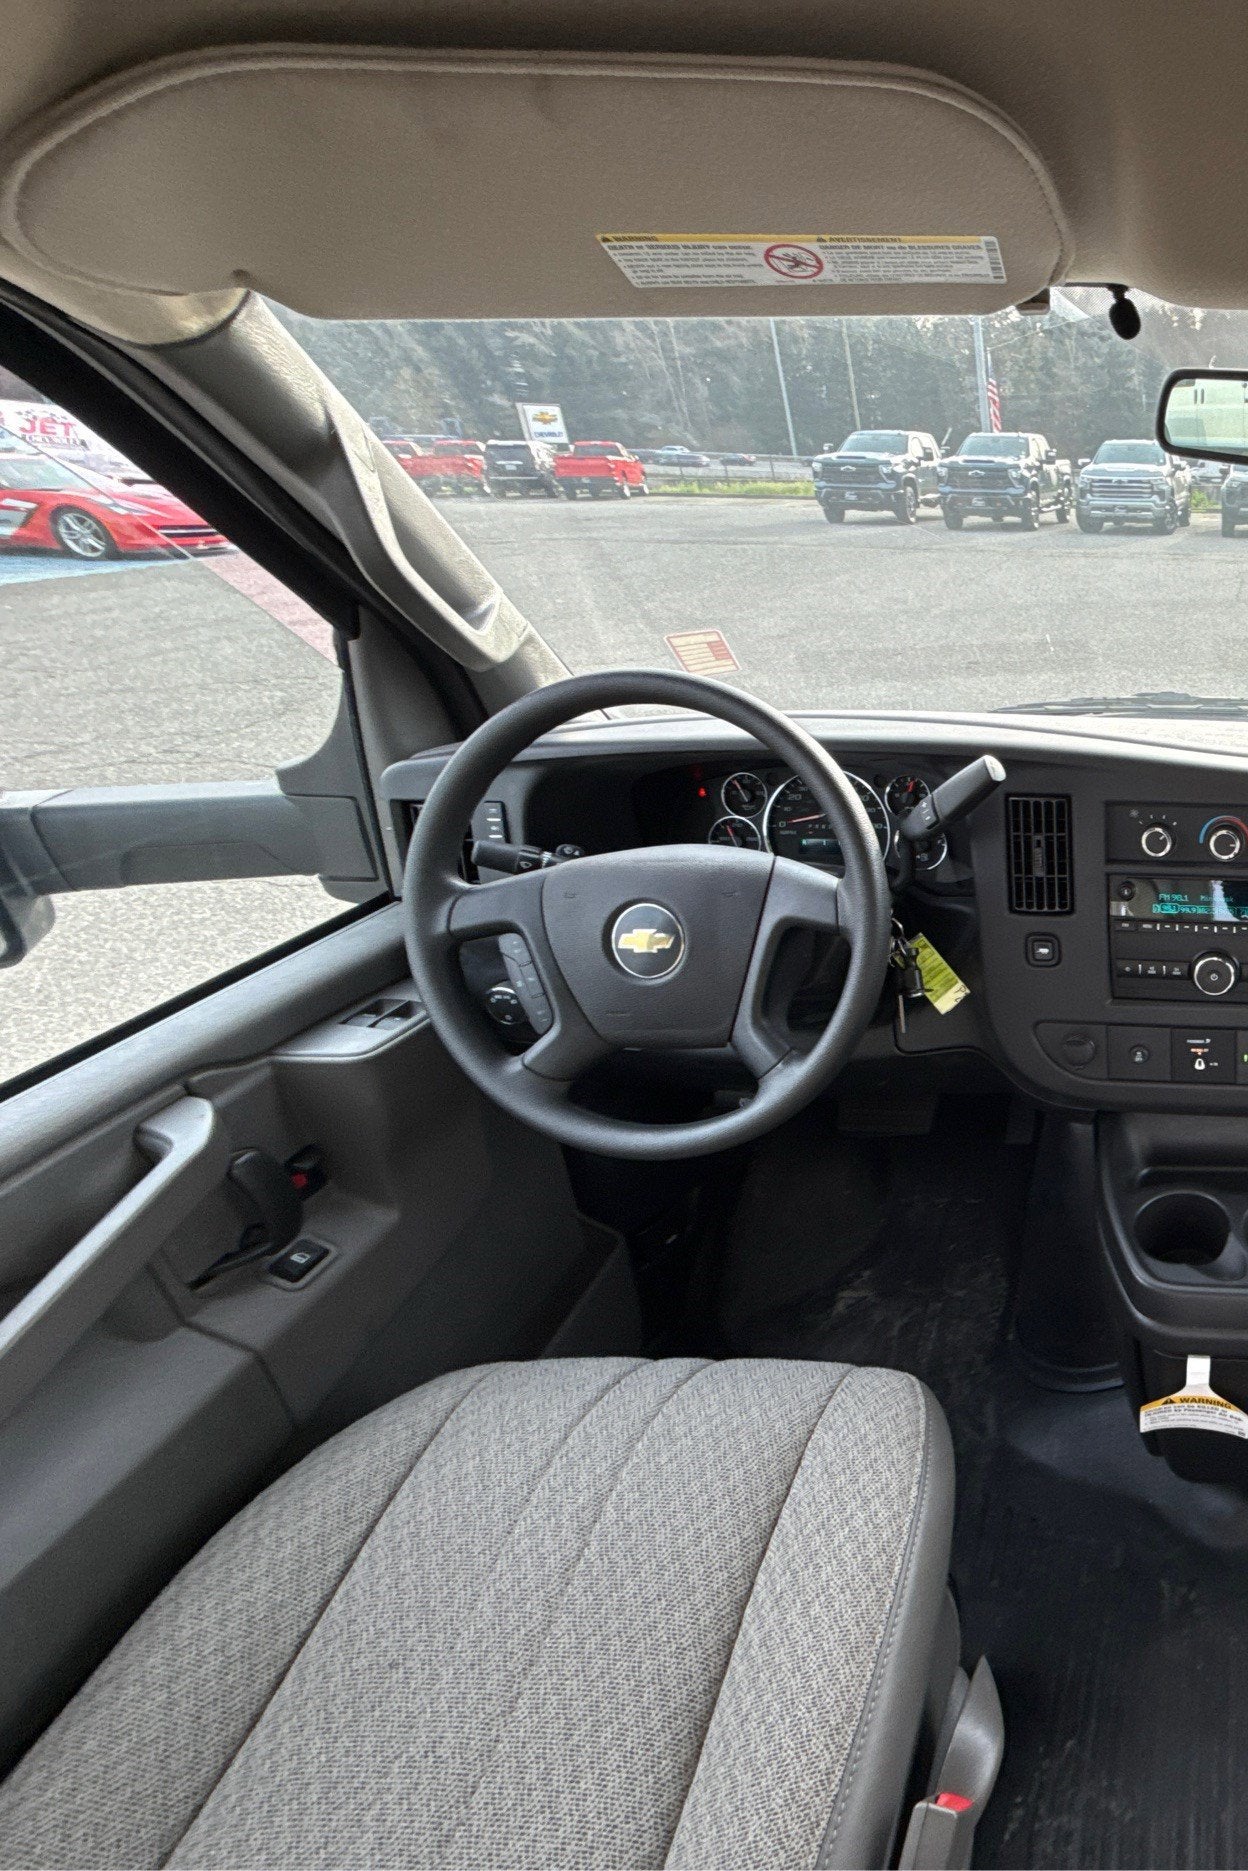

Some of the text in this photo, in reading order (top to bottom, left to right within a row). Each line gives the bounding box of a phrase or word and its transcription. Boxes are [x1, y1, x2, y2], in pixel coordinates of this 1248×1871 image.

[612, 235, 659, 243] WARNING
[19, 415, 77, 437] JET
[1180, 1397, 1232, 1409] WARNING
